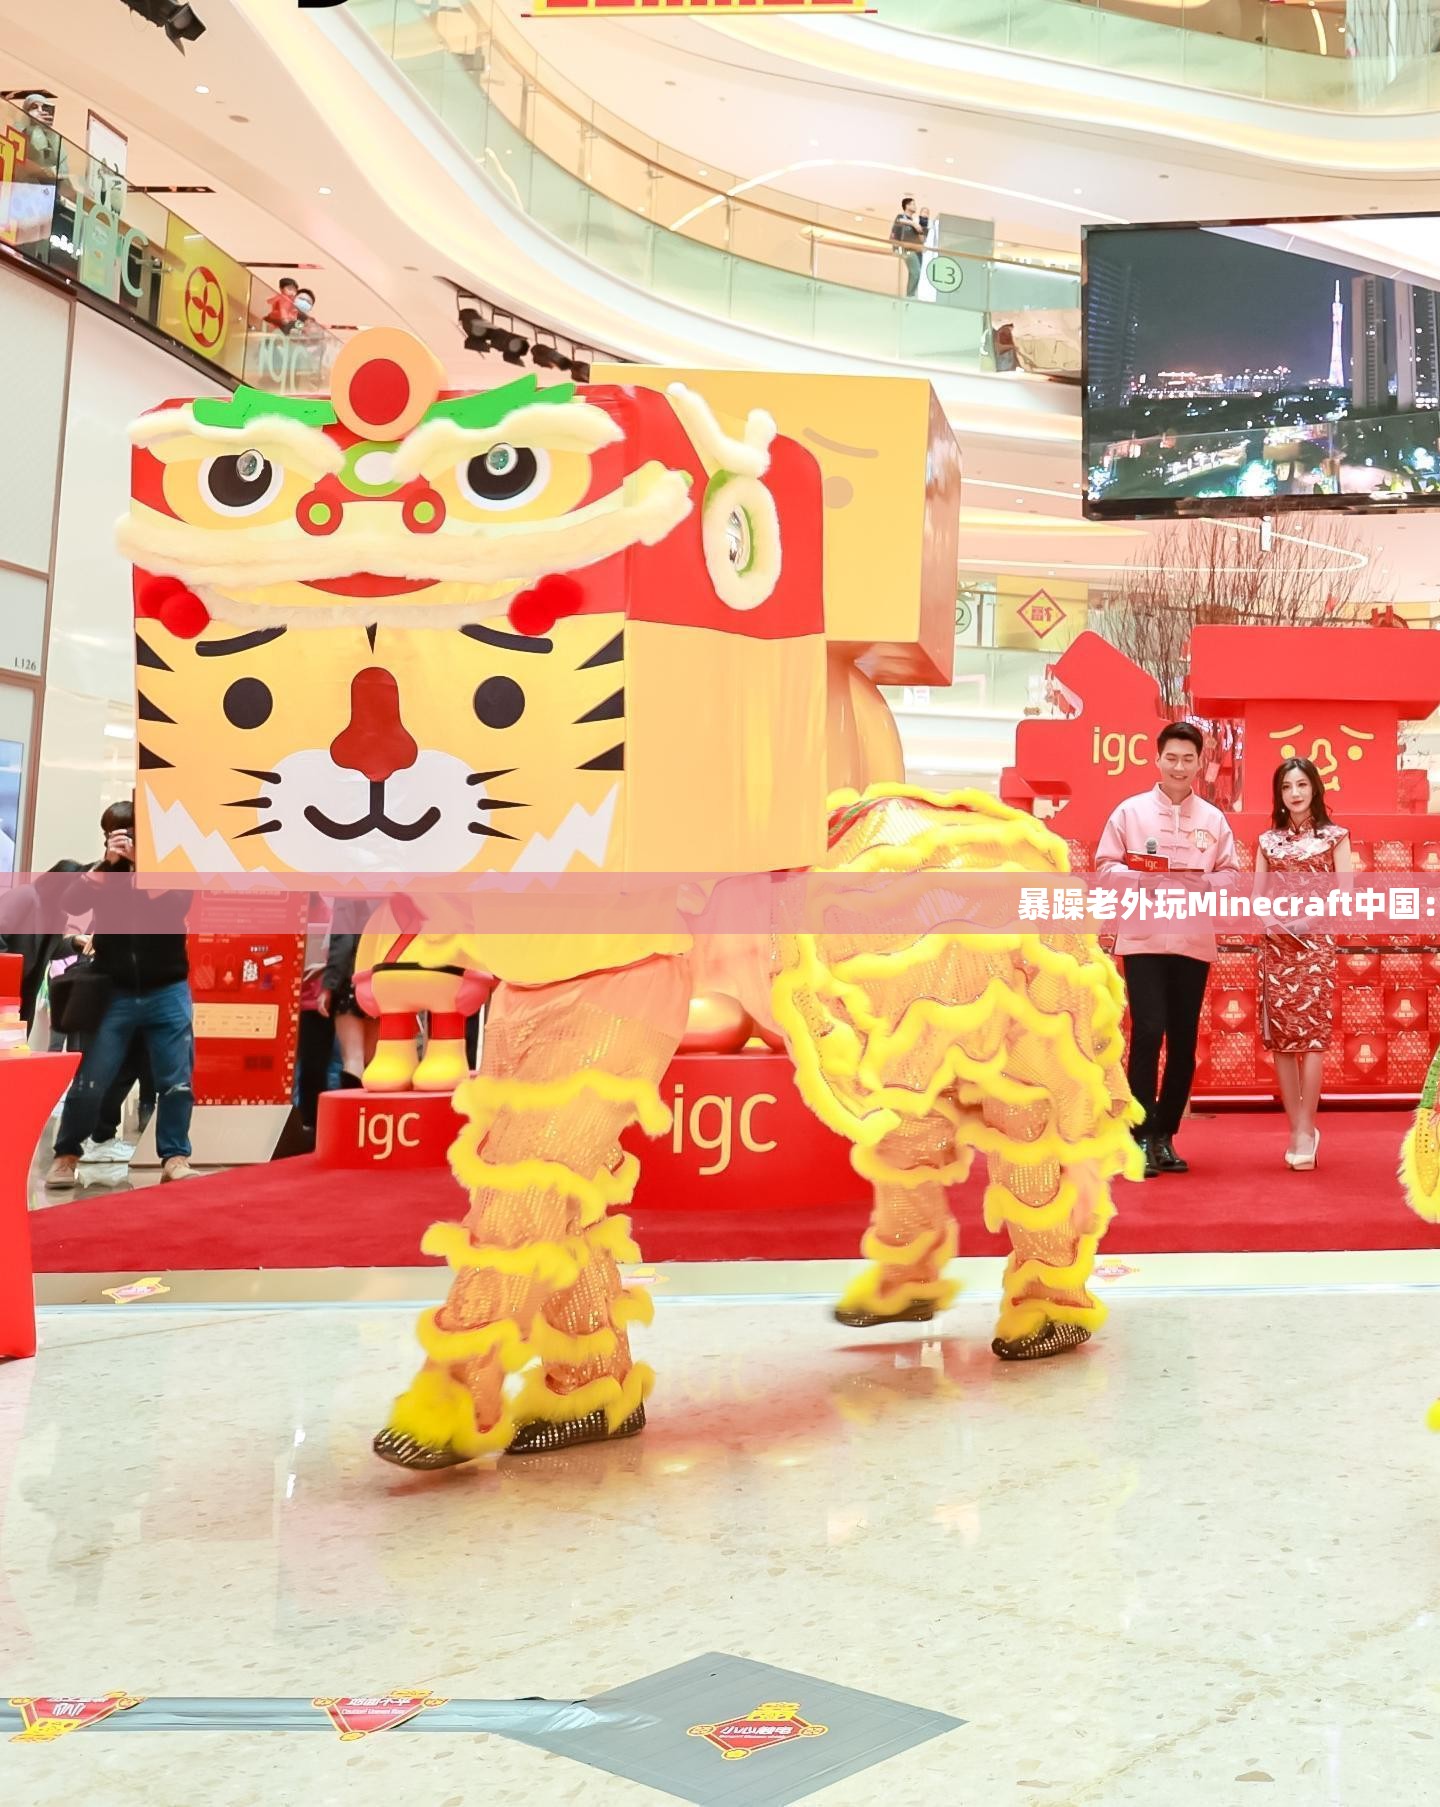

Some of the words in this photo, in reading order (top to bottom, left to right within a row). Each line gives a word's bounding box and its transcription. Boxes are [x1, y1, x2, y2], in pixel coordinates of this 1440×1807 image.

[932, 263, 956, 285] L3
[14, 655, 37, 672] L126
[1092, 726, 1148, 776] igc
[1144, 859, 1158, 871] igc
[358, 1107, 420, 1160] igc
[672, 1083, 777, 1175] igc
